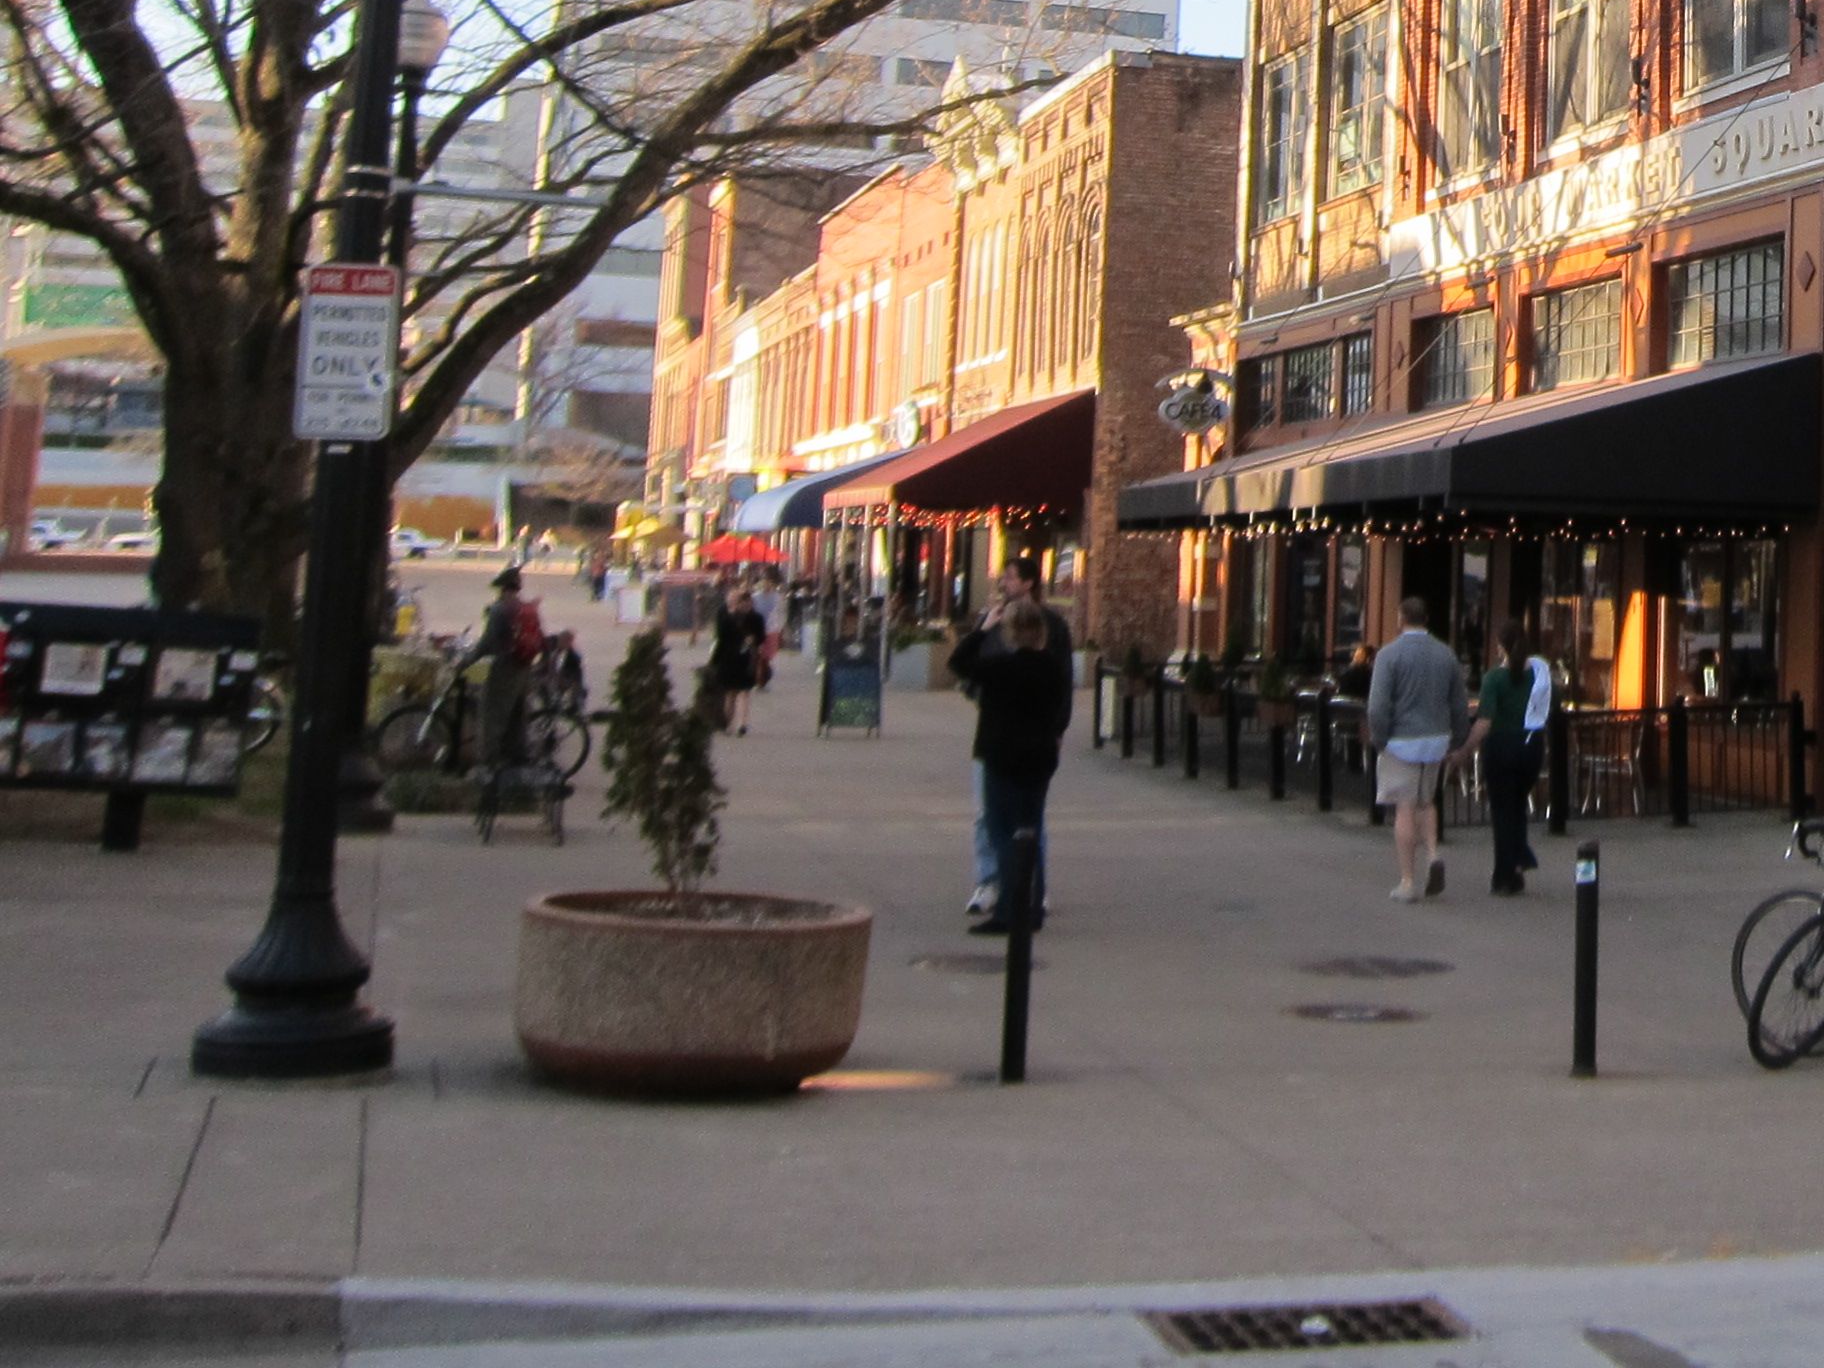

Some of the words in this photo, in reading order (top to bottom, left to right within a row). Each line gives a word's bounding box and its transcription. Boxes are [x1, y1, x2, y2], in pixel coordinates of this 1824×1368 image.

[1562, 145, 1683, 221] MARKET
[312, 271, 345, 290] FIRE
[351, 272, 393, 291] LANE
[311, 355, 380, 377] ONLY
